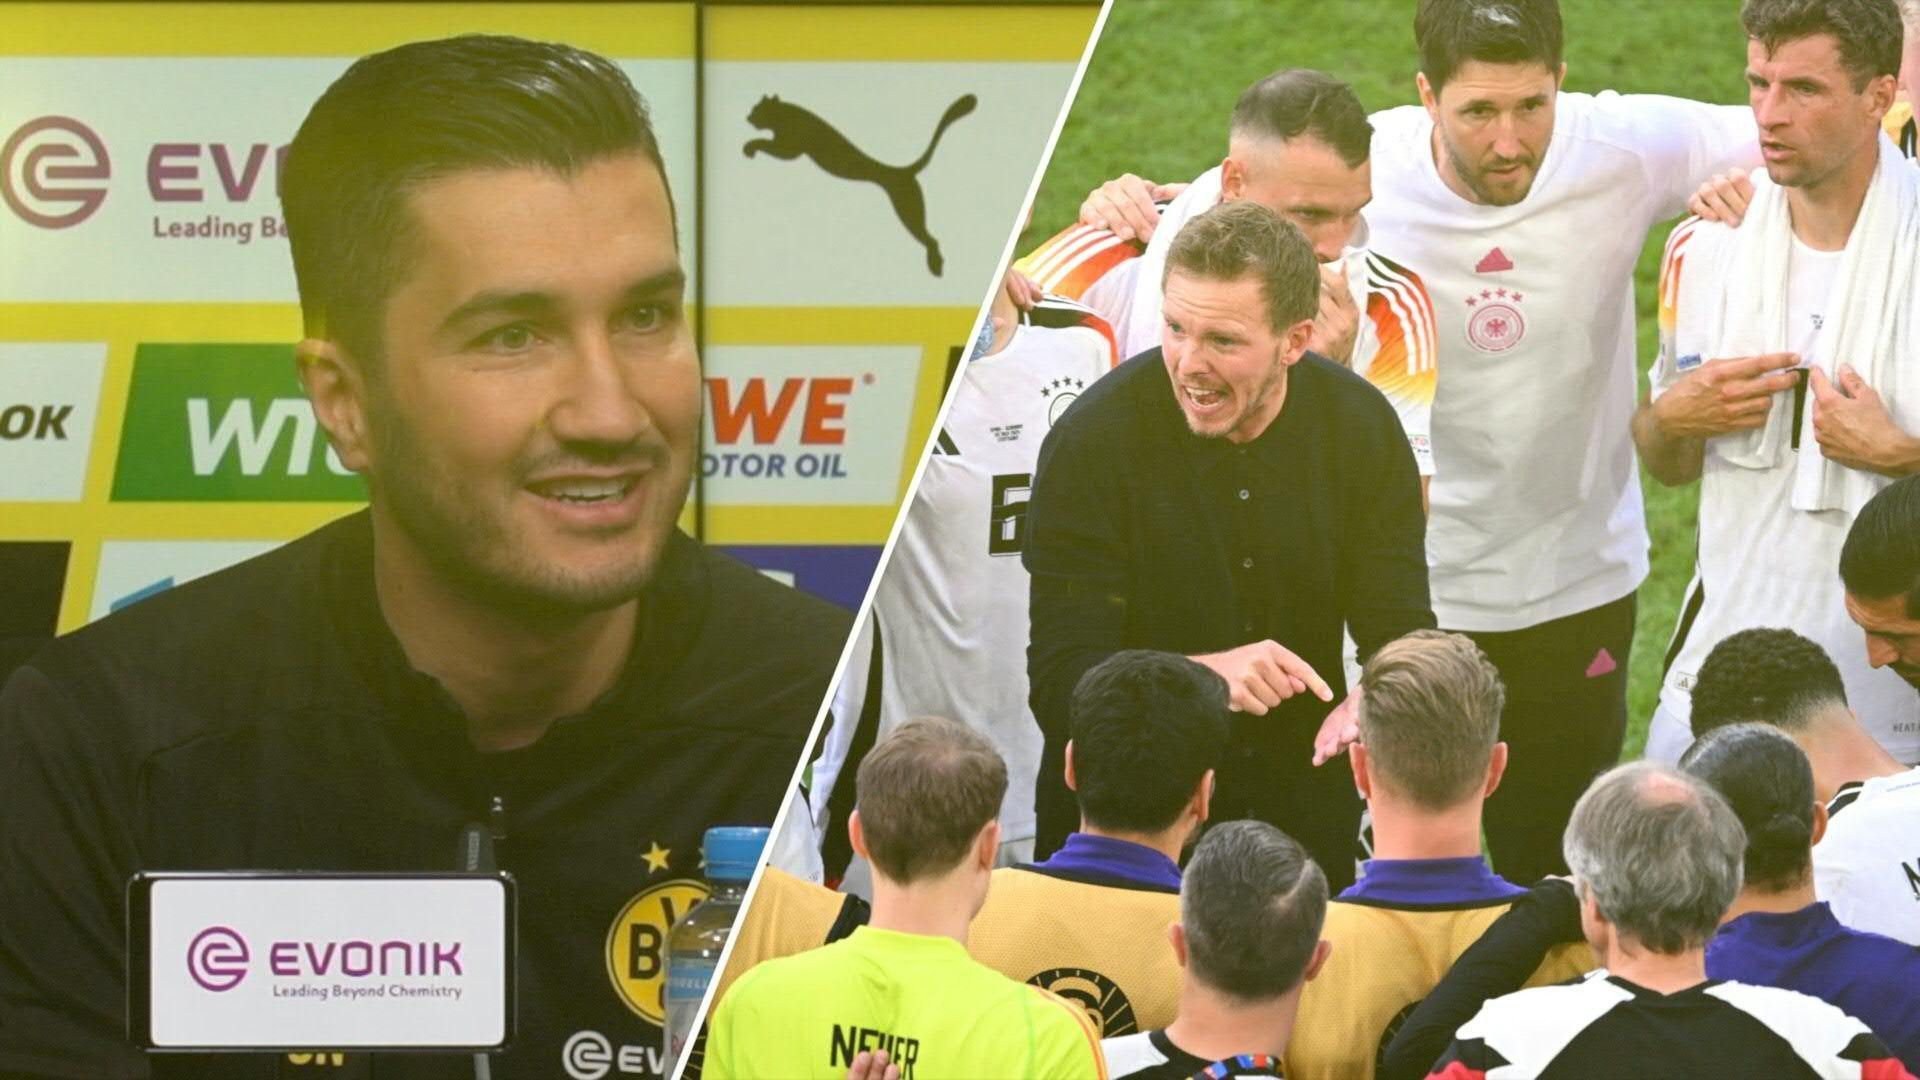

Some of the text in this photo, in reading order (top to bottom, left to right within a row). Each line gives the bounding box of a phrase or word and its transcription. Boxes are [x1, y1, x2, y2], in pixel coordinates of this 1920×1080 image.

[153, 216, 251, 244] Leading
[795, 453, 847, 478] OIL
[270, 941, 463, 977] EVONIK
[273, 985, 463, 1001] Leading Beyond Chemistry
